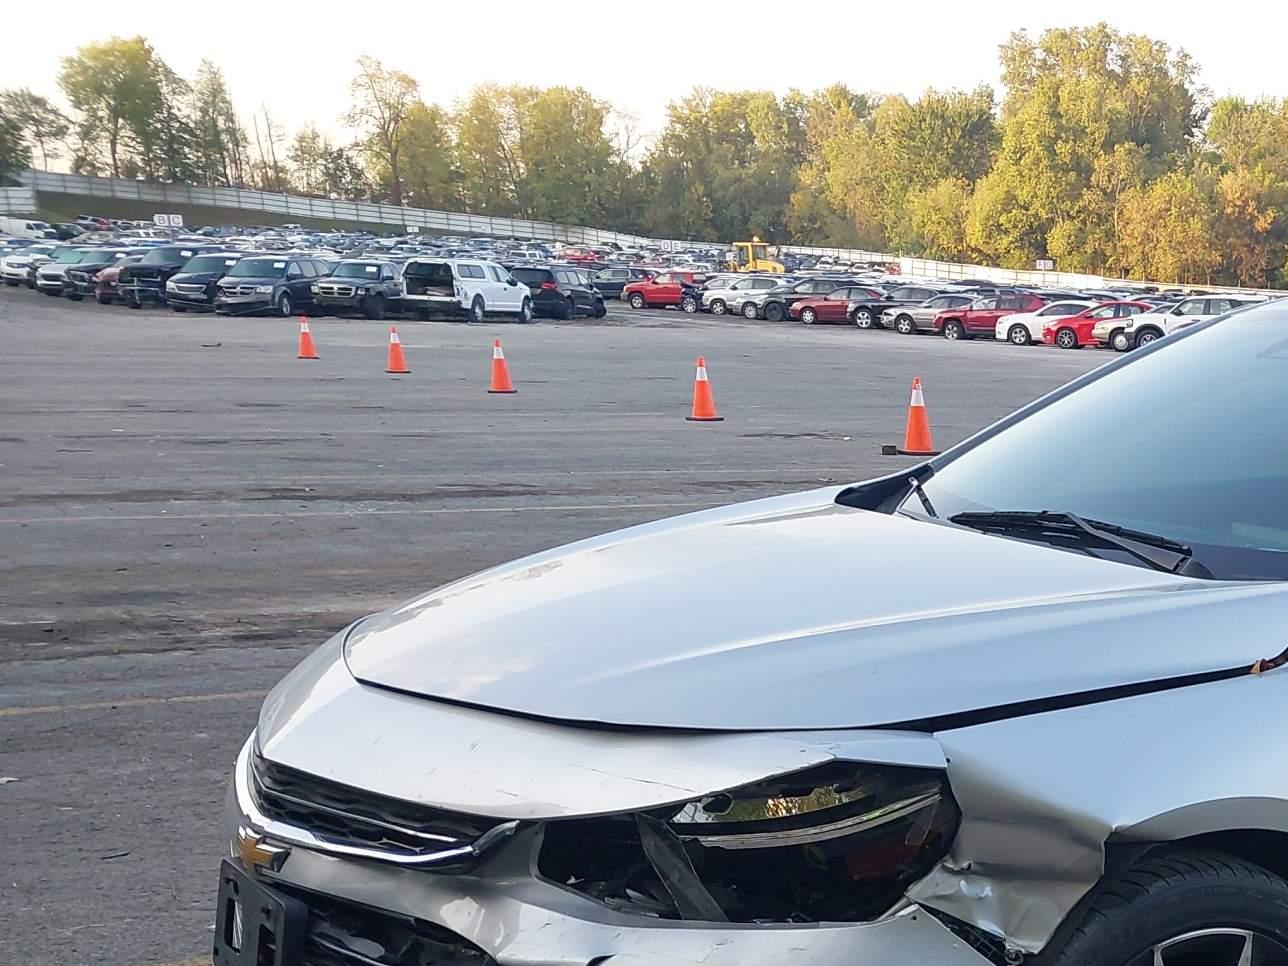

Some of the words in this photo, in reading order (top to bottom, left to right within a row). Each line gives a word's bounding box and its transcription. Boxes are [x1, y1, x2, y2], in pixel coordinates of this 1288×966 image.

[158, 215, 166, 224] B
[172, 215, 181, 225] C
[673, 242, 680, 251] E
